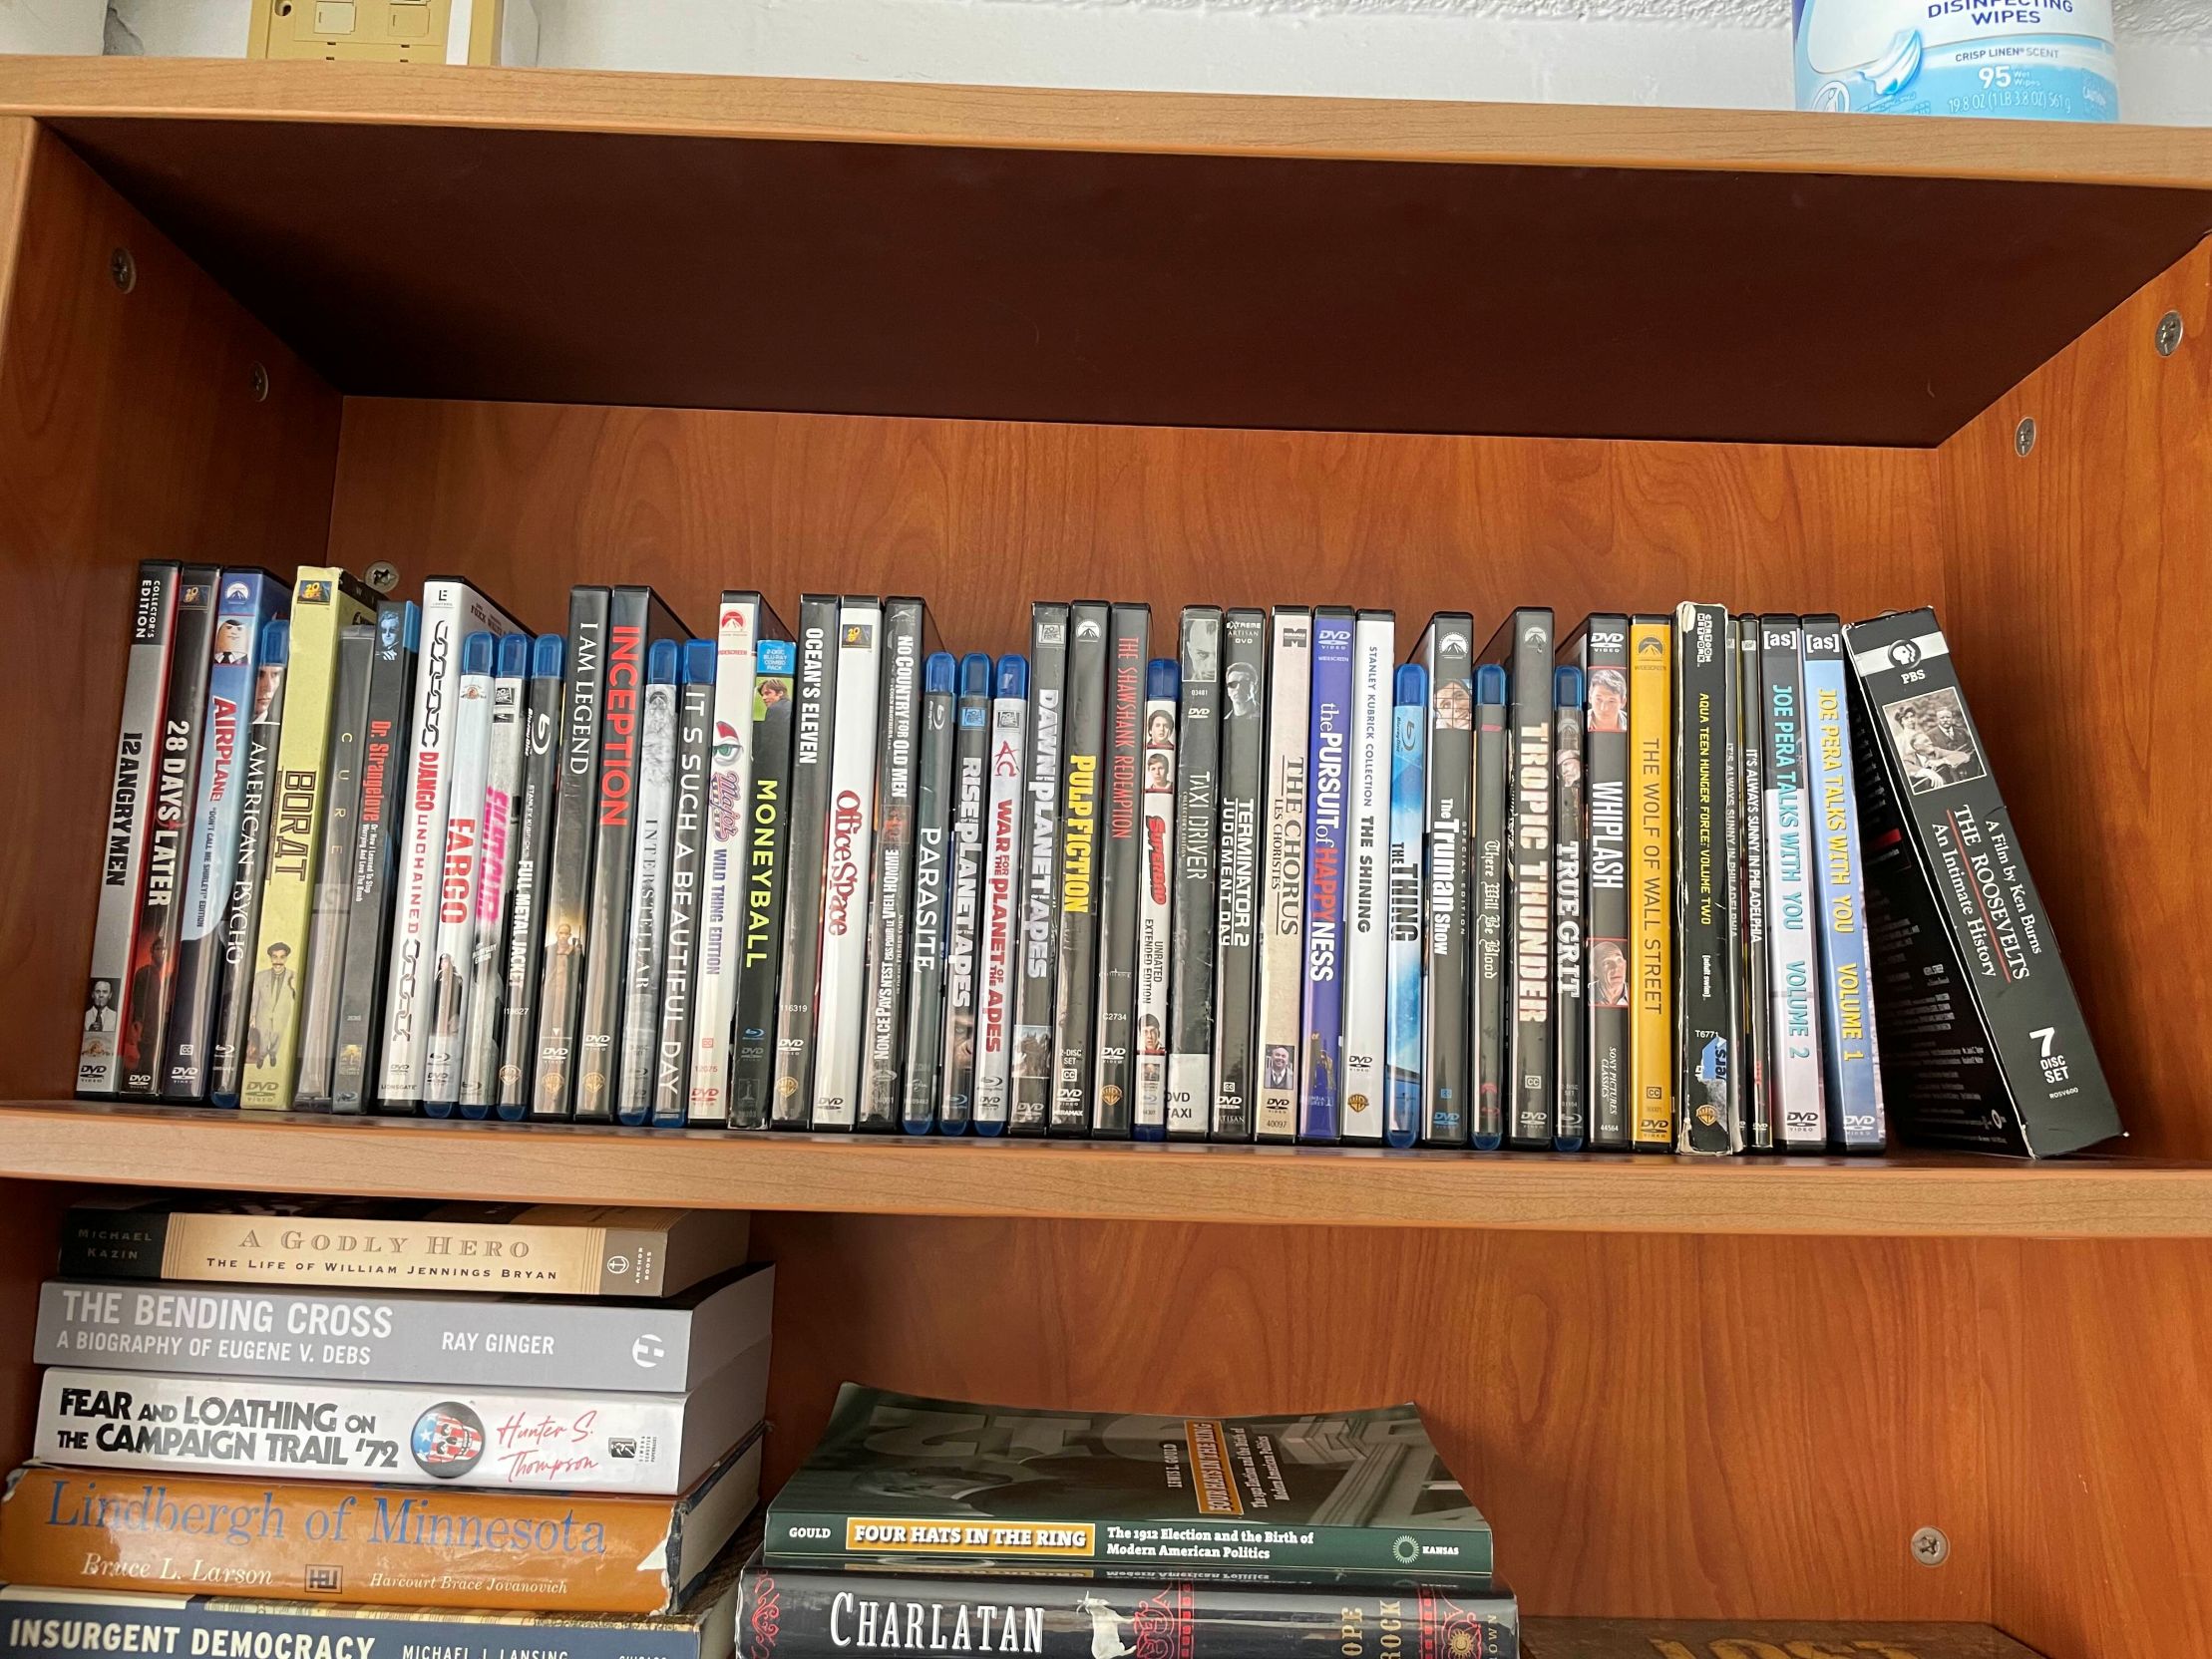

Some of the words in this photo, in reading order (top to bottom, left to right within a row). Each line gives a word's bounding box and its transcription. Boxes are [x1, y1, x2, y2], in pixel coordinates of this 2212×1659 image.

[1972, 10, 2040, 26] WIPES
[1955, 50, 1986, 63] CRISP
[2026, 48, 2059, 59] SCENT
[1978, 66, 2012, 89] 95
[136, 579, 153, 638] EDITION
[147, 580, 161, 638] COLLECTOR'S
[1118, 638, 1139, 659] THE
[1703, 614, 1712, 662] CARTOON
[802, 627, 824, 699] OCEAN'S
[1368, 645, 1378, 690] STANLEY
[1900, 670, 1926, 685] PBS
[1115, 667, 1139, 748] SHAWSHANK
[1365, 693, 1376, 740] KUBRICK
[1699, 693, 1710, 724] AQUA
[1772, 684, 1794, 718] JOE
[121, 732, 143, 756] 12
[165, 720, 189, 752] 28
[371, 720, 392, 738] Dr.
[599, 626, 640, 827] INCEPTION
[798, 702, 821, 765] ELEVEN
[1699, 728, 1710, 757] TEEN
[1774, 721, 1797, 768] PERA
[1363, 743, 1374, 807] COLLECTION
[1643, 738, 1659, 776] THE
[1746, 748, 1758, 767] IT'S
[113, 757, 140, 835] ANGRY
[158, 758, 186, 822] DAYS
[238, 742, 267, 865] AMERICAN
[361, 742, 390, 823] Strangelove
[414, 752, 439, 812] DJANGO
[1068, 755, 1097, 821] PULP
[1112, 755, 1136, 839] REDEMPTION
[1188, 771, 1210, 808] TAXI
[1285, 757, 1303, 815] THE
[1520, 722, 1550, 850] TROPIC
[1699, 759, 1710, 804] HUNGER
[1746, 769, 1760, 814] ALWAYS
[1776, 772, 1799, 828] TALKS
[1274, 799, 1284, 821] LES
[1360, 816, 1374, 848] THE
[1643, 783, 1660, 838] WOLF
[1699, 806, 1710, 847] FORCE:
[1747, 815, 1761, 852] SUNNY
[1186, 816, 1209, 880] DRIVER
[1272, 824, 1284, 890] CHORISTES
[1391, 841, 1405, 864] THE
[1592, 781, 1624, 889] WHIPLASH
[1644, 844, 1660, 870] OF
[1778, 831, 1801, 882] WITH
[106, 835, 130, 885] MEN
[148, 830, 179, 905] LATER
[408, 815, 429, 934] UNCHAINED
[441, 819, 476, 924] FARGO
[746, 780, 778, 968] MONEYBALL
[1063, 818, 1094, 914] FICTION
[1146, 815, 1167, 905] SUPERBAD
[1281, 820, 1301, 936] CHORUS
[1556, 840, 1580, 917] TRUE
[1699, 849, 1711, 894] VOLUME
[1748, 854, 1761, 867] IN
[635, 820, 658, 989] INTERSTELLAR
[914, 827, 942, 973] PARASITE
[1357, 855, 1373, 933] SHINING
[1390, 863, 1419, 942] THING
[1644, 876, 1660, 931] WALL
[1700, 896, 1711, 925] TWO
[1749, 868, 1763, 943] PHILADELPHIA
[1781, 892, 1804, 930] YOU
[1932, 823, 1950, 847] An
[1942, 847, 1974, 915] Intimate
[1967, 917, 1998, 978] History
[1954, 805, 1983, 846] THE
[1971, 852, 2030, 981] ROOSEVELTS
[225, 880, 253, 965] PSYCHO
[1144, 918, 1154, 966] EXTENDED
[1518, 860, 1549, 1022] THUNDER
[1153, 940, 1164, 983] UNRATED
[1556, 920, 1581, 999] GRIT
[1645, 939, 1662, 1015] STREET
[1142, 968, 1153, 1004] EDITION
[1785, 960, 1809, 1037] VOLUME
[1789, 1046, 1809, 1059] 2
[2028, 1026, 2056, 1058] 7
[1600, 1124, 1619, 1133] 44564
[78, 1228, 153, 1242] MICHAEL
[87, 1246, 139, 1260] KAZIN
[206, 1257, 238, 1268] THE
[248, 1259, 286, 1270] LIFE
[295, 1261, 315, 1271] OF
[325, 1262, 398, 1274] WILLIAM
[407, 1265, 491, 1277] JENNINGS
[501, 1267, 557, 1280] BRYAN
[634, 1247, 643, 1284] ANCHOR
[62, 1289, 121, 1325] THE
[135, 1295, 274, 1334] BENDING
[286, 1302, 393, 1338] CROSS
[56, 1331, 70, 1349] A
[76, 1331, 184, 1357] BIOGRAPHY
[189, 1338, 211, 1358] OF
[217, 1340, 292, 1362] EUGENE
[299, 1344, 314, 1363] V.
[322, 1345, 371, 1366] DEBS
[442, 1331, 479, 1351] RAY
[485, 1334, 554, 1356] GINGER
[59, 1387, 133, 1420] FEAR
[138, 1403, 178, 1423] AND
[184, 1395, 338, 1433] LOATHING
[344, 1414, 376, 1434] ON
[497, 1411, 567, 1449] Hunter
[570, 1410, 598, 1443] S.
[57, 1430, 89, 1450] THE
[95, 1424, 256, 1461] CAMPAIGN
[264, 1432, 350, 1466] TRAIL
[497, 1449, 600, 1483] Thompson
[45, 1480, 285, 1546] Lindbergh
[304, 1494, 358, 1542] of
[367, 1496, 607, 1555] Minnesota
[789, 1526, 832, 1538] GOULD
[854, 1524, 907, 1544] FOUR
[910, 1525, 962, 1544] HATS
[965, 1526, 989, 1544] IN
[992, 1528, 1034, 1546] THE
[1036, 1529, 1088, 1548] RING
[1107, 1526, 1131, 1540] The
[1133, 1529, 1159, 1541] 1912
[1160, 1527, 1212, 1542] Election
[1214, 1529, 1239, 1543] and
[1241, 1530, 1263, 1543] the
[1265, 1530, 1297, 1544] Birth
[1300, 1531, 1314, 1544] of
[1107, 1543, 1157, 1557] Modern
[1159, 1544, 1220, 1558] American
[1223, 1546, 1271, 1560] Politics
[1421, 1545, 1459, 1555] KANSAS
[369, 1572, 438, 1589] Harcourt
[439, 1575, 483, 1591] Brace
[486, 1577, 567, 1594] Jovanovich
[10, 1618, 181, 1654] INSURGENT
[190, 1628, 376, 1659] DEMOCRACY
[830, 1591, 1046, 1655] CHARLATAN
